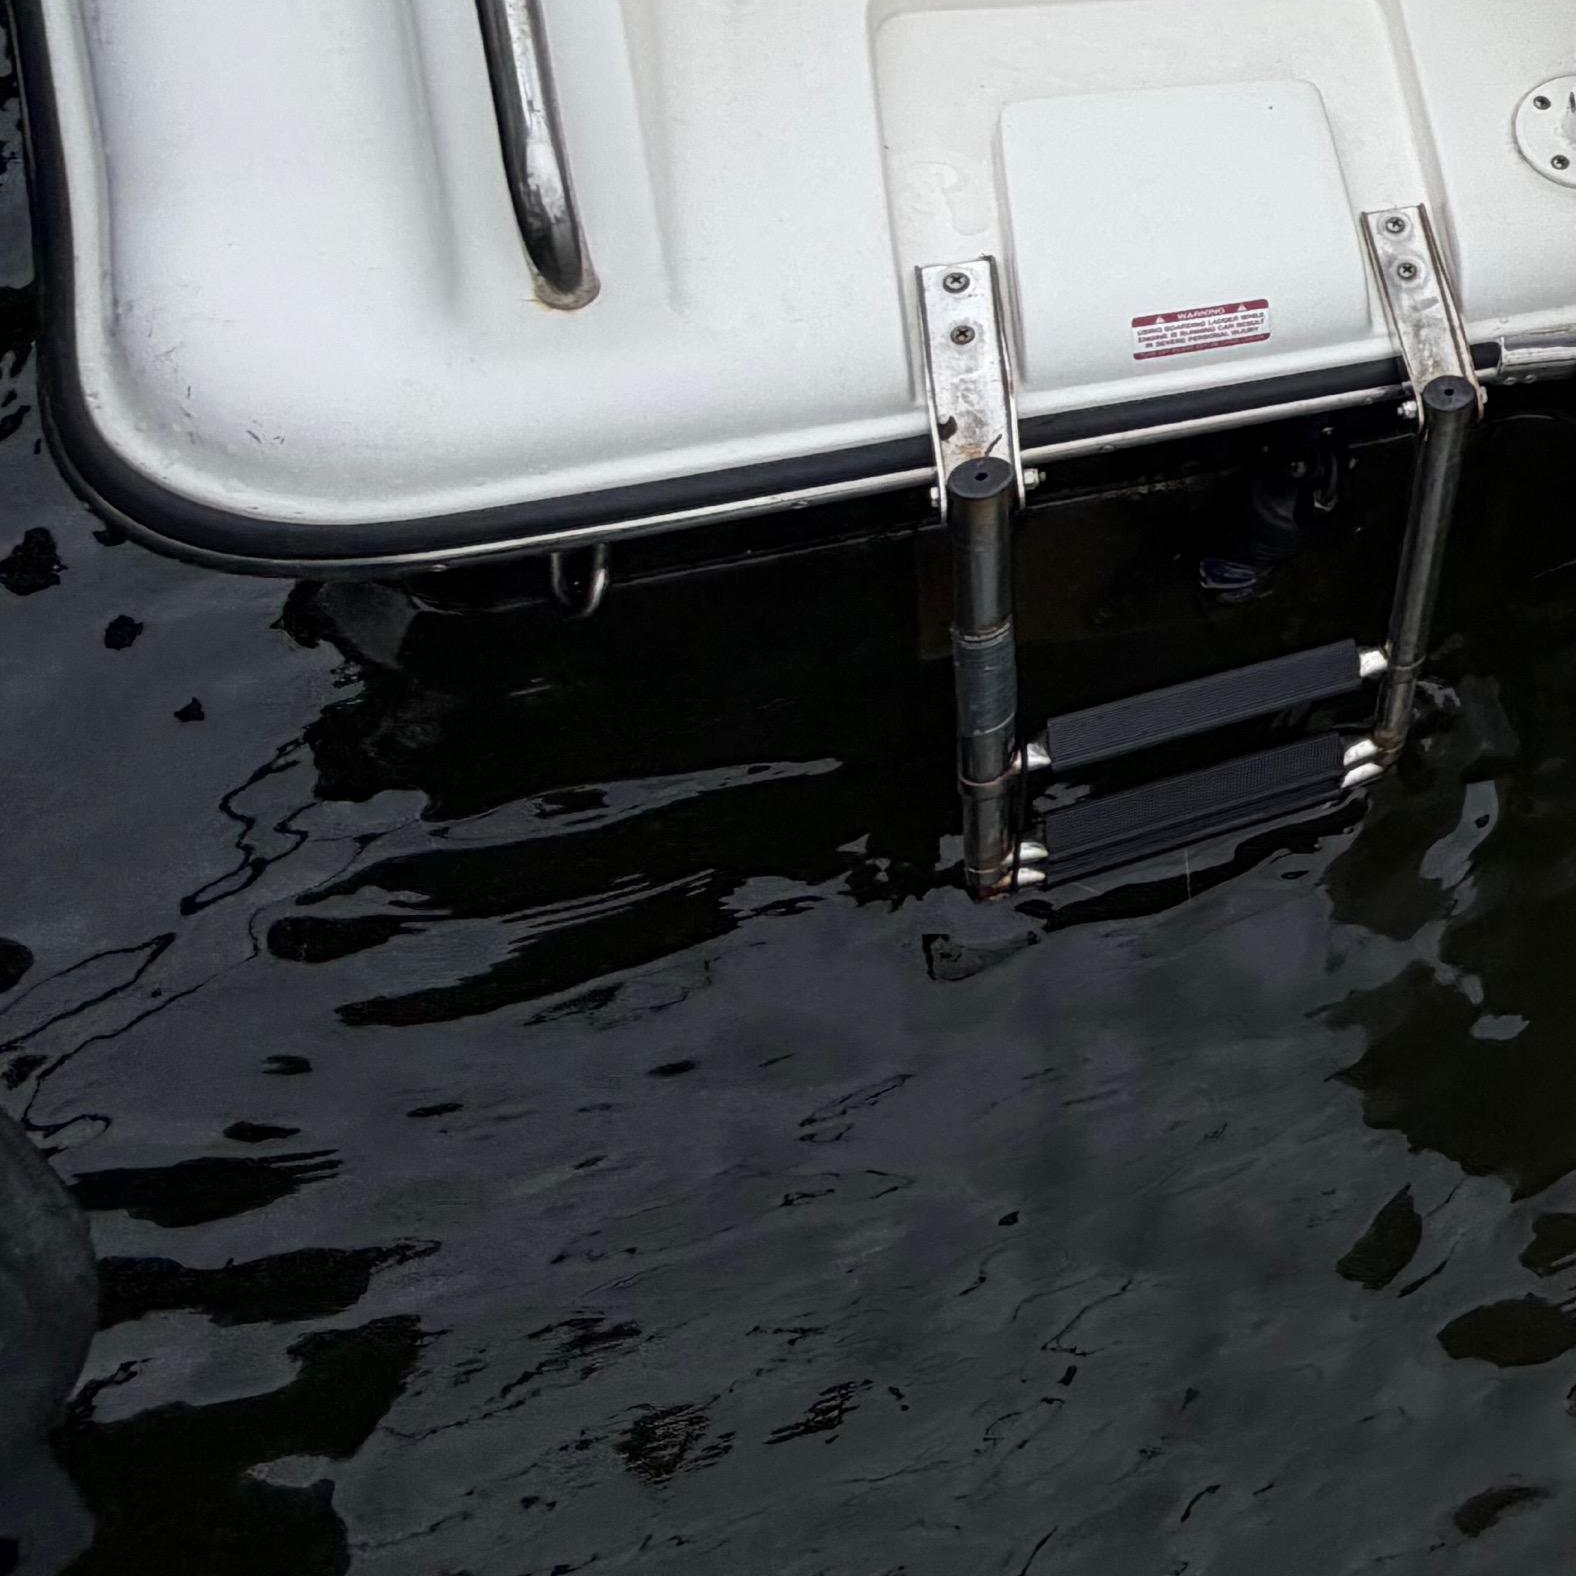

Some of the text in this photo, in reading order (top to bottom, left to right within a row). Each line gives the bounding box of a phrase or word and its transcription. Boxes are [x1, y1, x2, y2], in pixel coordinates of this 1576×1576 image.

[1177, 307, 1225, 319] WARNING
[1137, 327, 1162, 336] USING
[1164, 321, 1205, 332] BOARDING
[1208, 316, 1239, 325] LADDER
[1138, 333, 1167, 343] ENGINE
[1180, 327, 1216, 336] RUNNING
